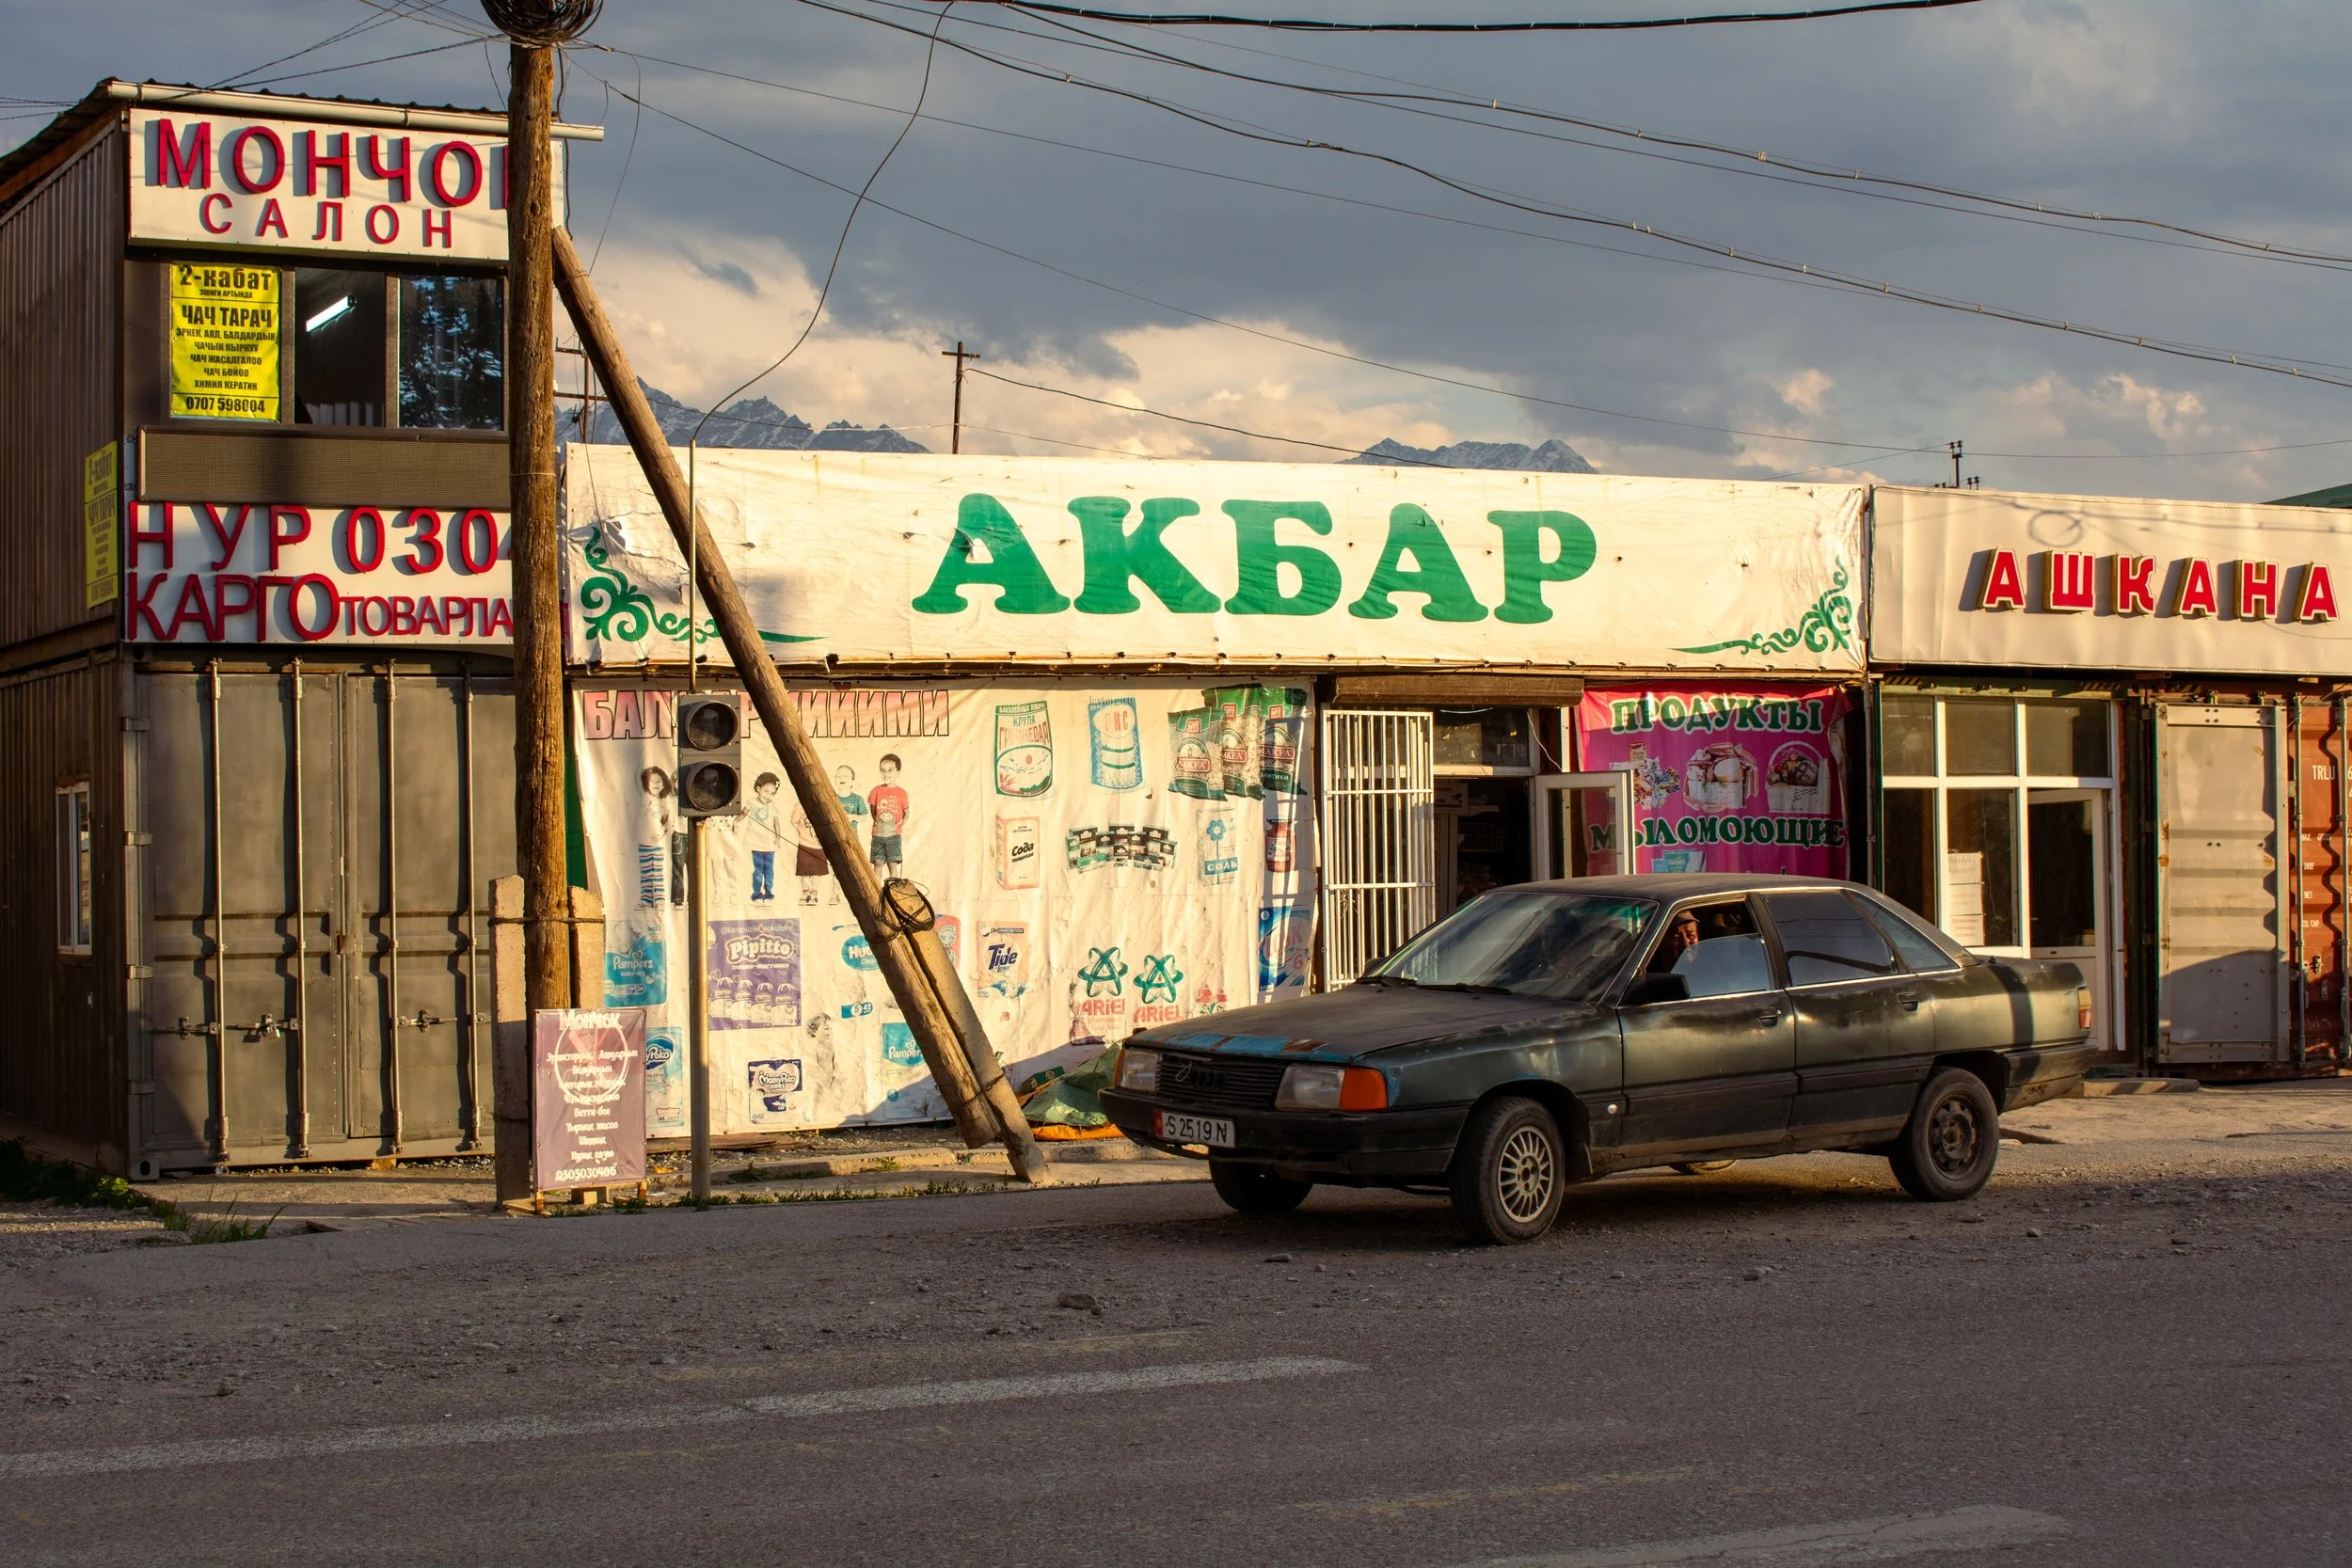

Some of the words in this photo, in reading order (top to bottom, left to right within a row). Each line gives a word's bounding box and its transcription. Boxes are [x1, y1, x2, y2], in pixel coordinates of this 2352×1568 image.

[157, 118, 509, 210] МОНЧО
[200, 192, 453, 248] САЛОН
[180, 264, 272, 291] 2-кабат
[182, 305, 216, 325] ЧАЧ
[219, 307, 272, 328] ТАРАЧ
[194, 341, 224, 352] ЧАЧЫН
[223, 331, 276, 341] БАЛДАРДЫН
[190, 354, 208, 363] ЧАЧ
[203, 367, 221, 376] ЧАЧ
[194, 379, 223, 388] ХИМИЯ
[224, 380, 258, 390] КЕРАТИН
[185, 396, 214, 411] 0707
[217, 398, 265, 413] 598004
[128, 500, 311, 571] НУР
[346, 506, 511, 574] 030
[912, 492, 1597, 625] АКБАР
[1979, 546, 2341, 623] АШКАНА
[128, 570, 340, 641] КАРГО
[340, 595, 514, 637] ТОВАРЛА
[583, 689, 760, 746] БАЛР
[1609, 691, 1823, 735] ПРОДУКТЫ
[2312, 765, 2335, 781] TRLU
[1011, 842, 1035, 857] Сода
[1206, 860, 1238, 873] СОЛЬ
[612, 956, 654, 971] Pampers
[988, 943, 1019, 971] Tide
[888, 1046, 924, 1059] Pamper
[1168, 1115, 1177, 1135] S
[1179, 1117, 1212, 1141] 2519
[1216, 1121, 1228, 1144] N
